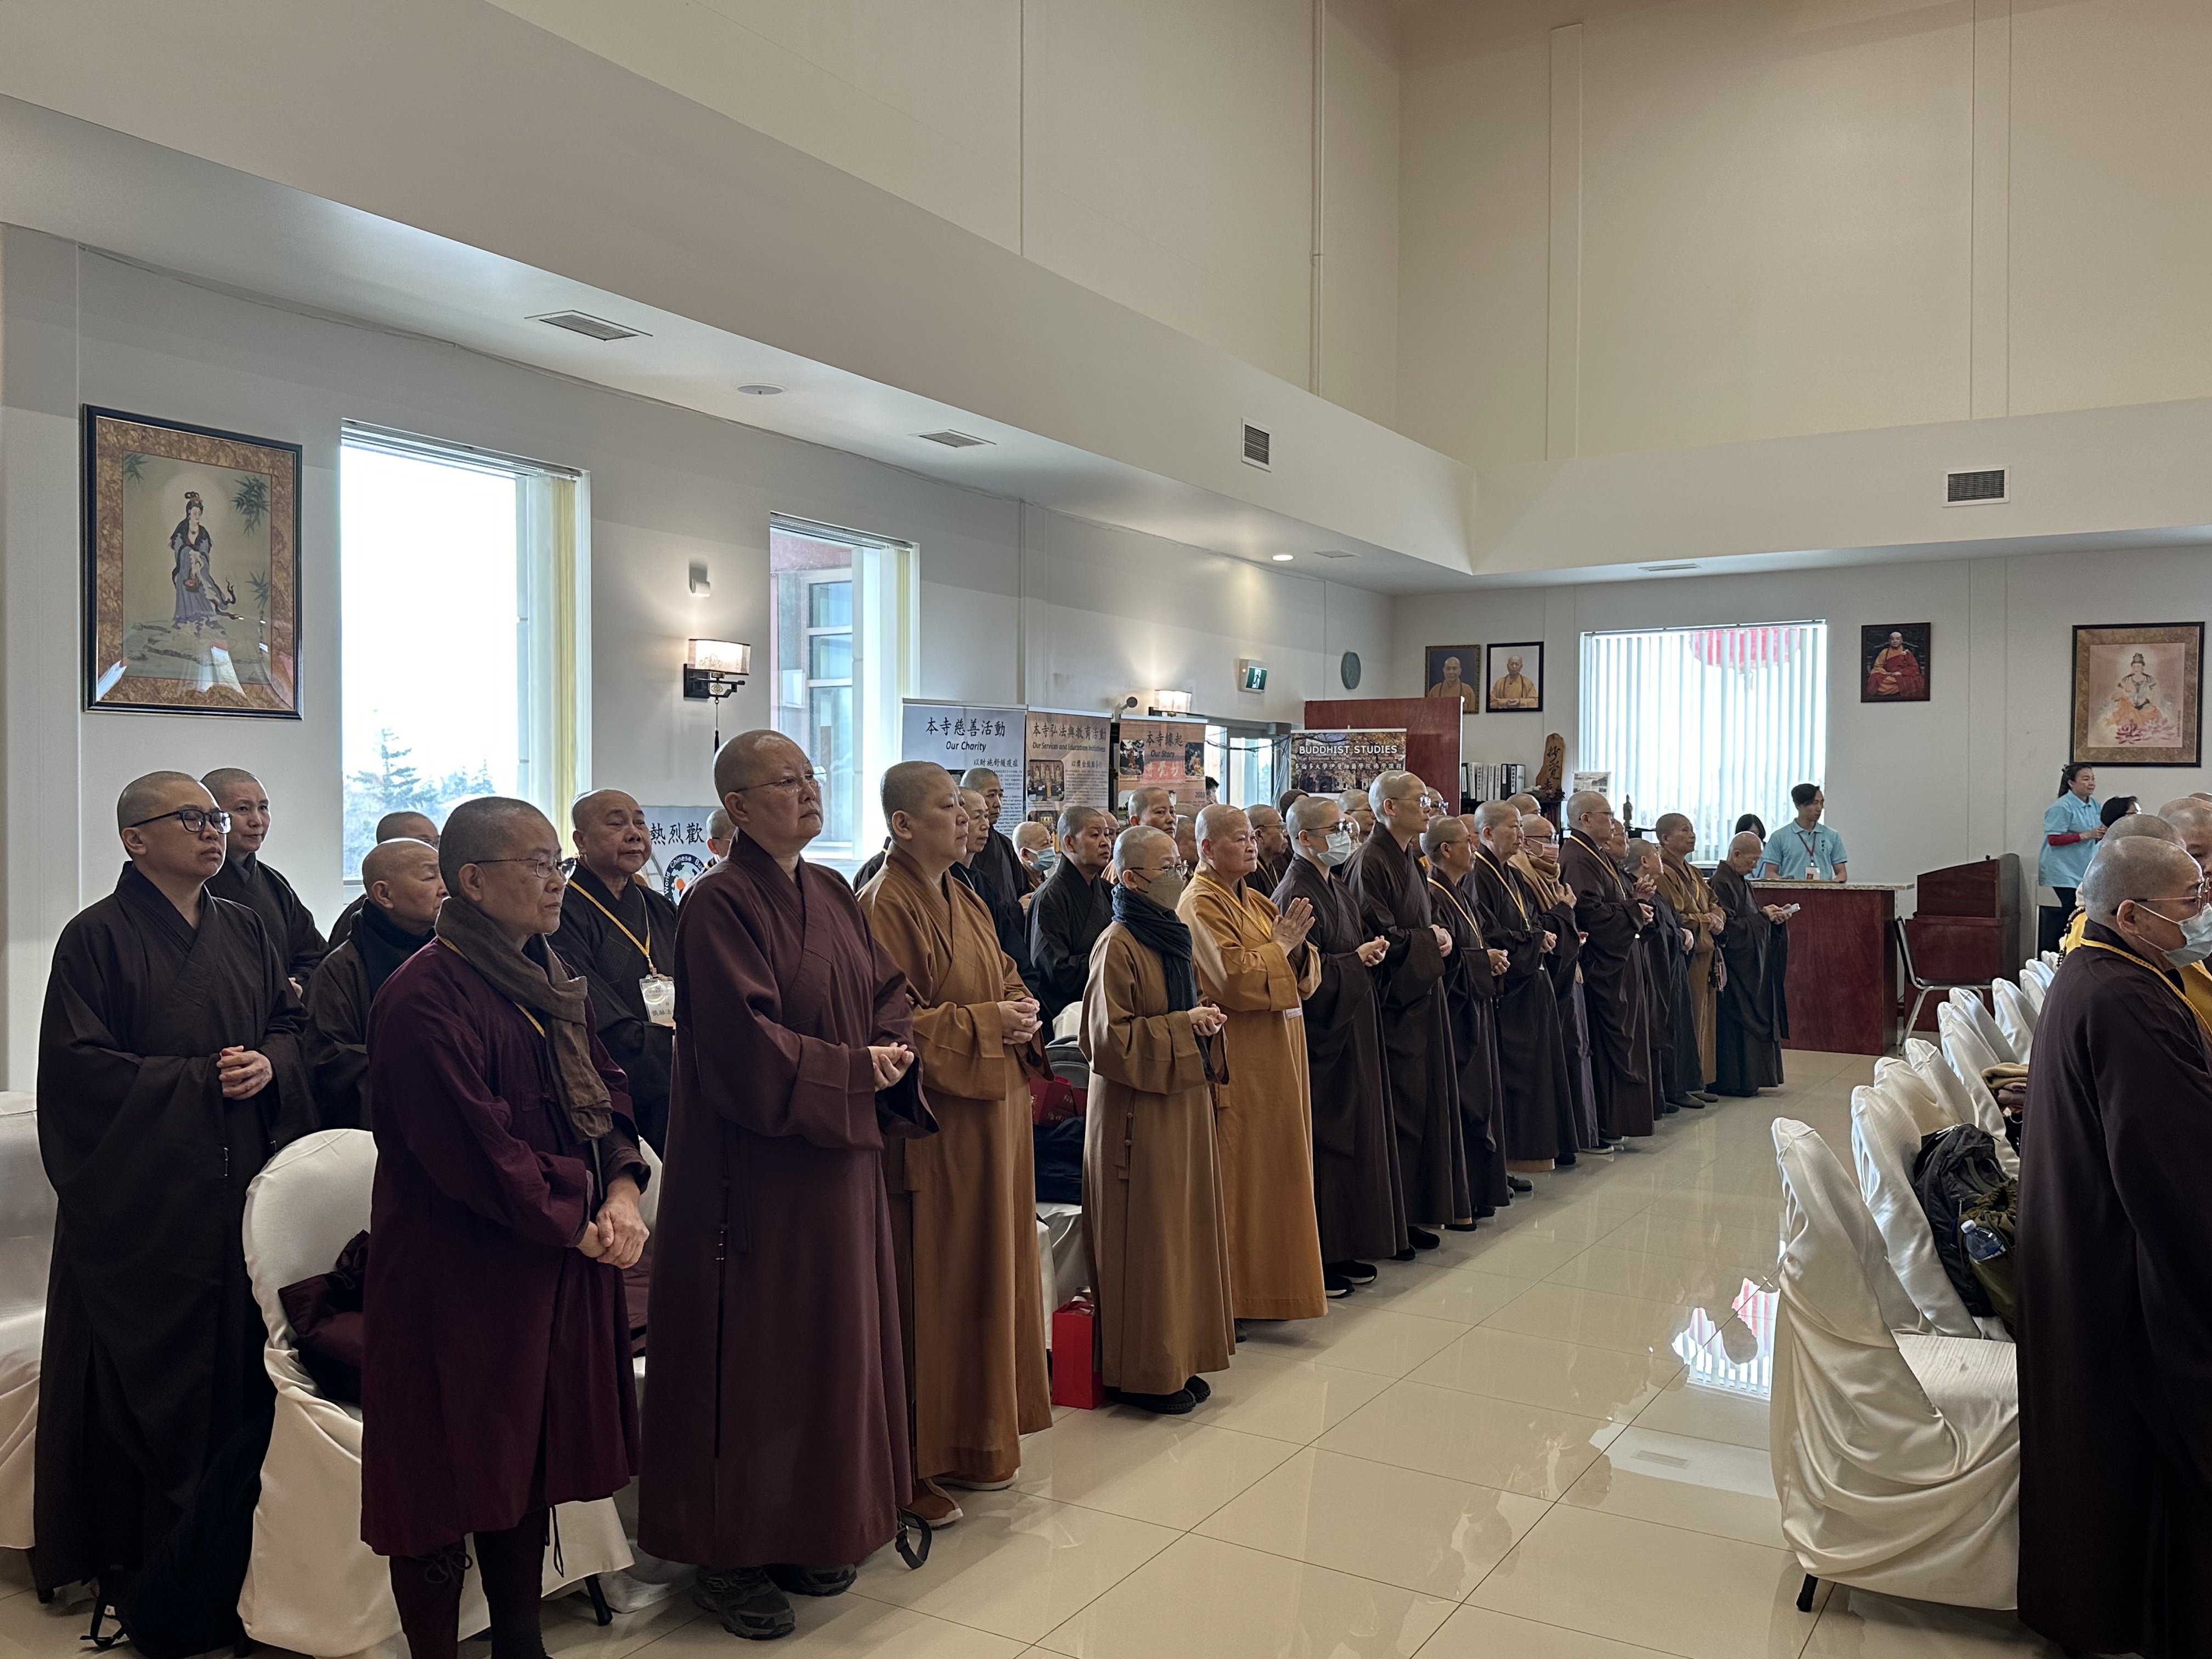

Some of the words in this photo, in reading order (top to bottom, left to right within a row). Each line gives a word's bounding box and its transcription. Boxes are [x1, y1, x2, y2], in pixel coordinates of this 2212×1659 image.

[926, 717, 1006, 737] 本寺慈善活動
[1033, 722, 1107, 741] 本寺弘法與教育活動
[1146, 730, 1183, 747] 本寺緣起
[946, 741, 959, 750] Our
[961, 741, 987, 753] Charity
[1299, 745, 1350, 754] BUDDHIST
[1354, 745, 1397, 754] STUDIES
[1161, 750, 1176, 759] Story
[650, 822, 706, 845] 熱烈歡
[670, 856, 692, 868] Chinese
